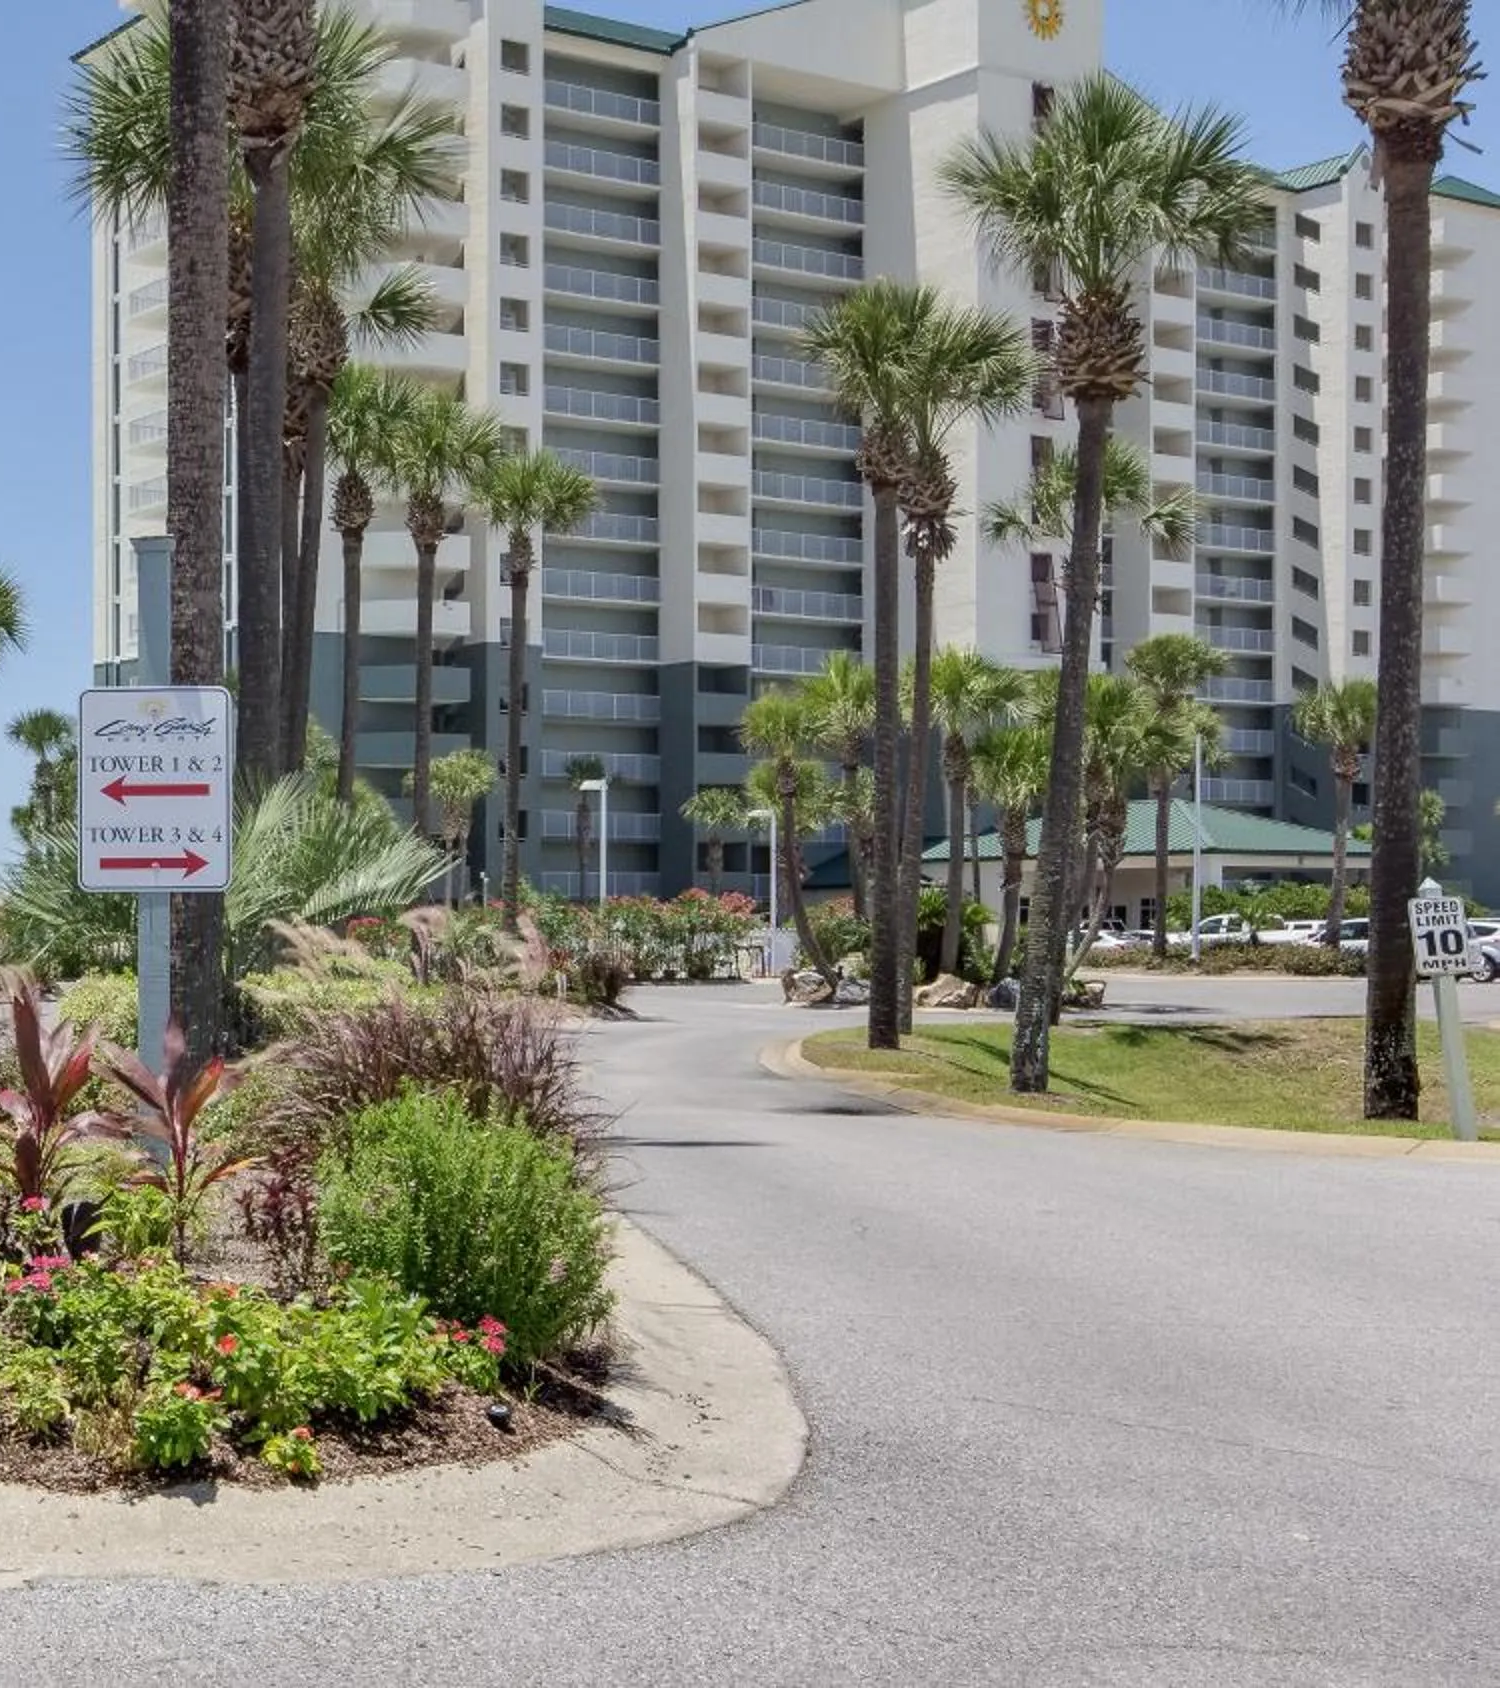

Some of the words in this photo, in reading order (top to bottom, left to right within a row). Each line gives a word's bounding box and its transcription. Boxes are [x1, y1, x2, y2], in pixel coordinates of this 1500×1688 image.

[87, 756, 164, 773] TOWER
[172, 757, 179, 772] 1
[187, 756, 204, 772] &
[211, 755, 223, 772] 2
[87, 827, 164, 843] TOWER
[171, 827, 181, 843] 3
[187, 827, 205, 843] &
[211, 825, 223, 843] 4
[1415, 901, 1459, 914] SPEED
[1416, 914, 1459, 927] LIMIT
[1417, 929, 1464, 957] 10
